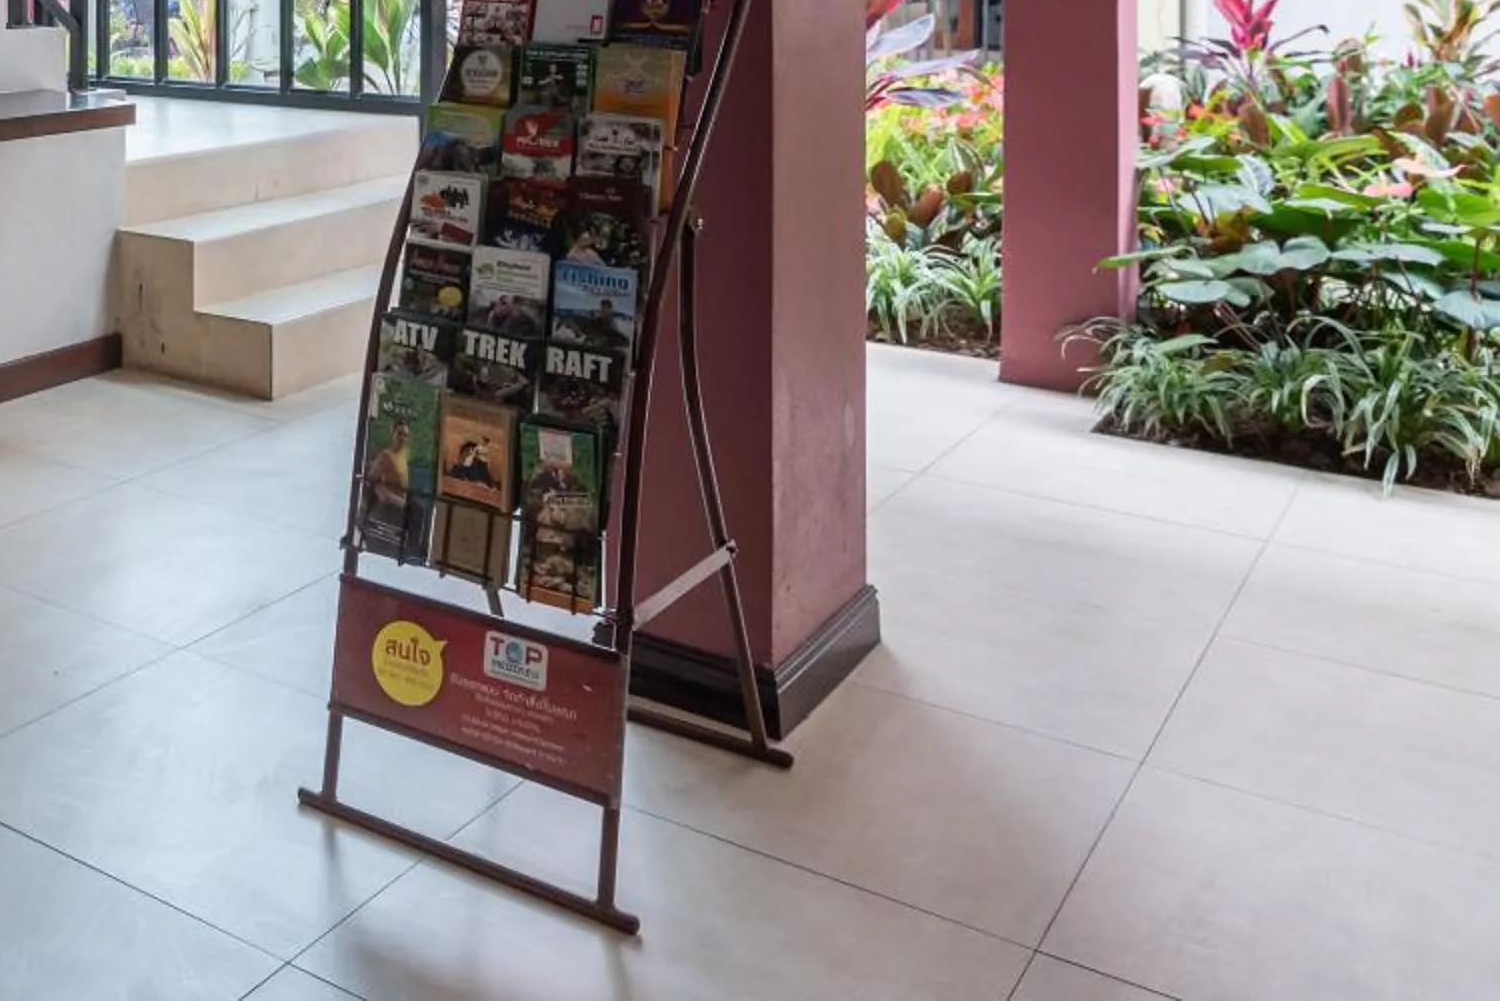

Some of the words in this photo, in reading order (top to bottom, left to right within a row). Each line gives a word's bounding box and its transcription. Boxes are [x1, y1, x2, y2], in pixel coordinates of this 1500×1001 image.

[394, 318, 438, 351] ATV
[462, 329, 528, 369] TREK
[546, 346, 613, 383] RAFT
[490, 636, 543, 665] TOP
